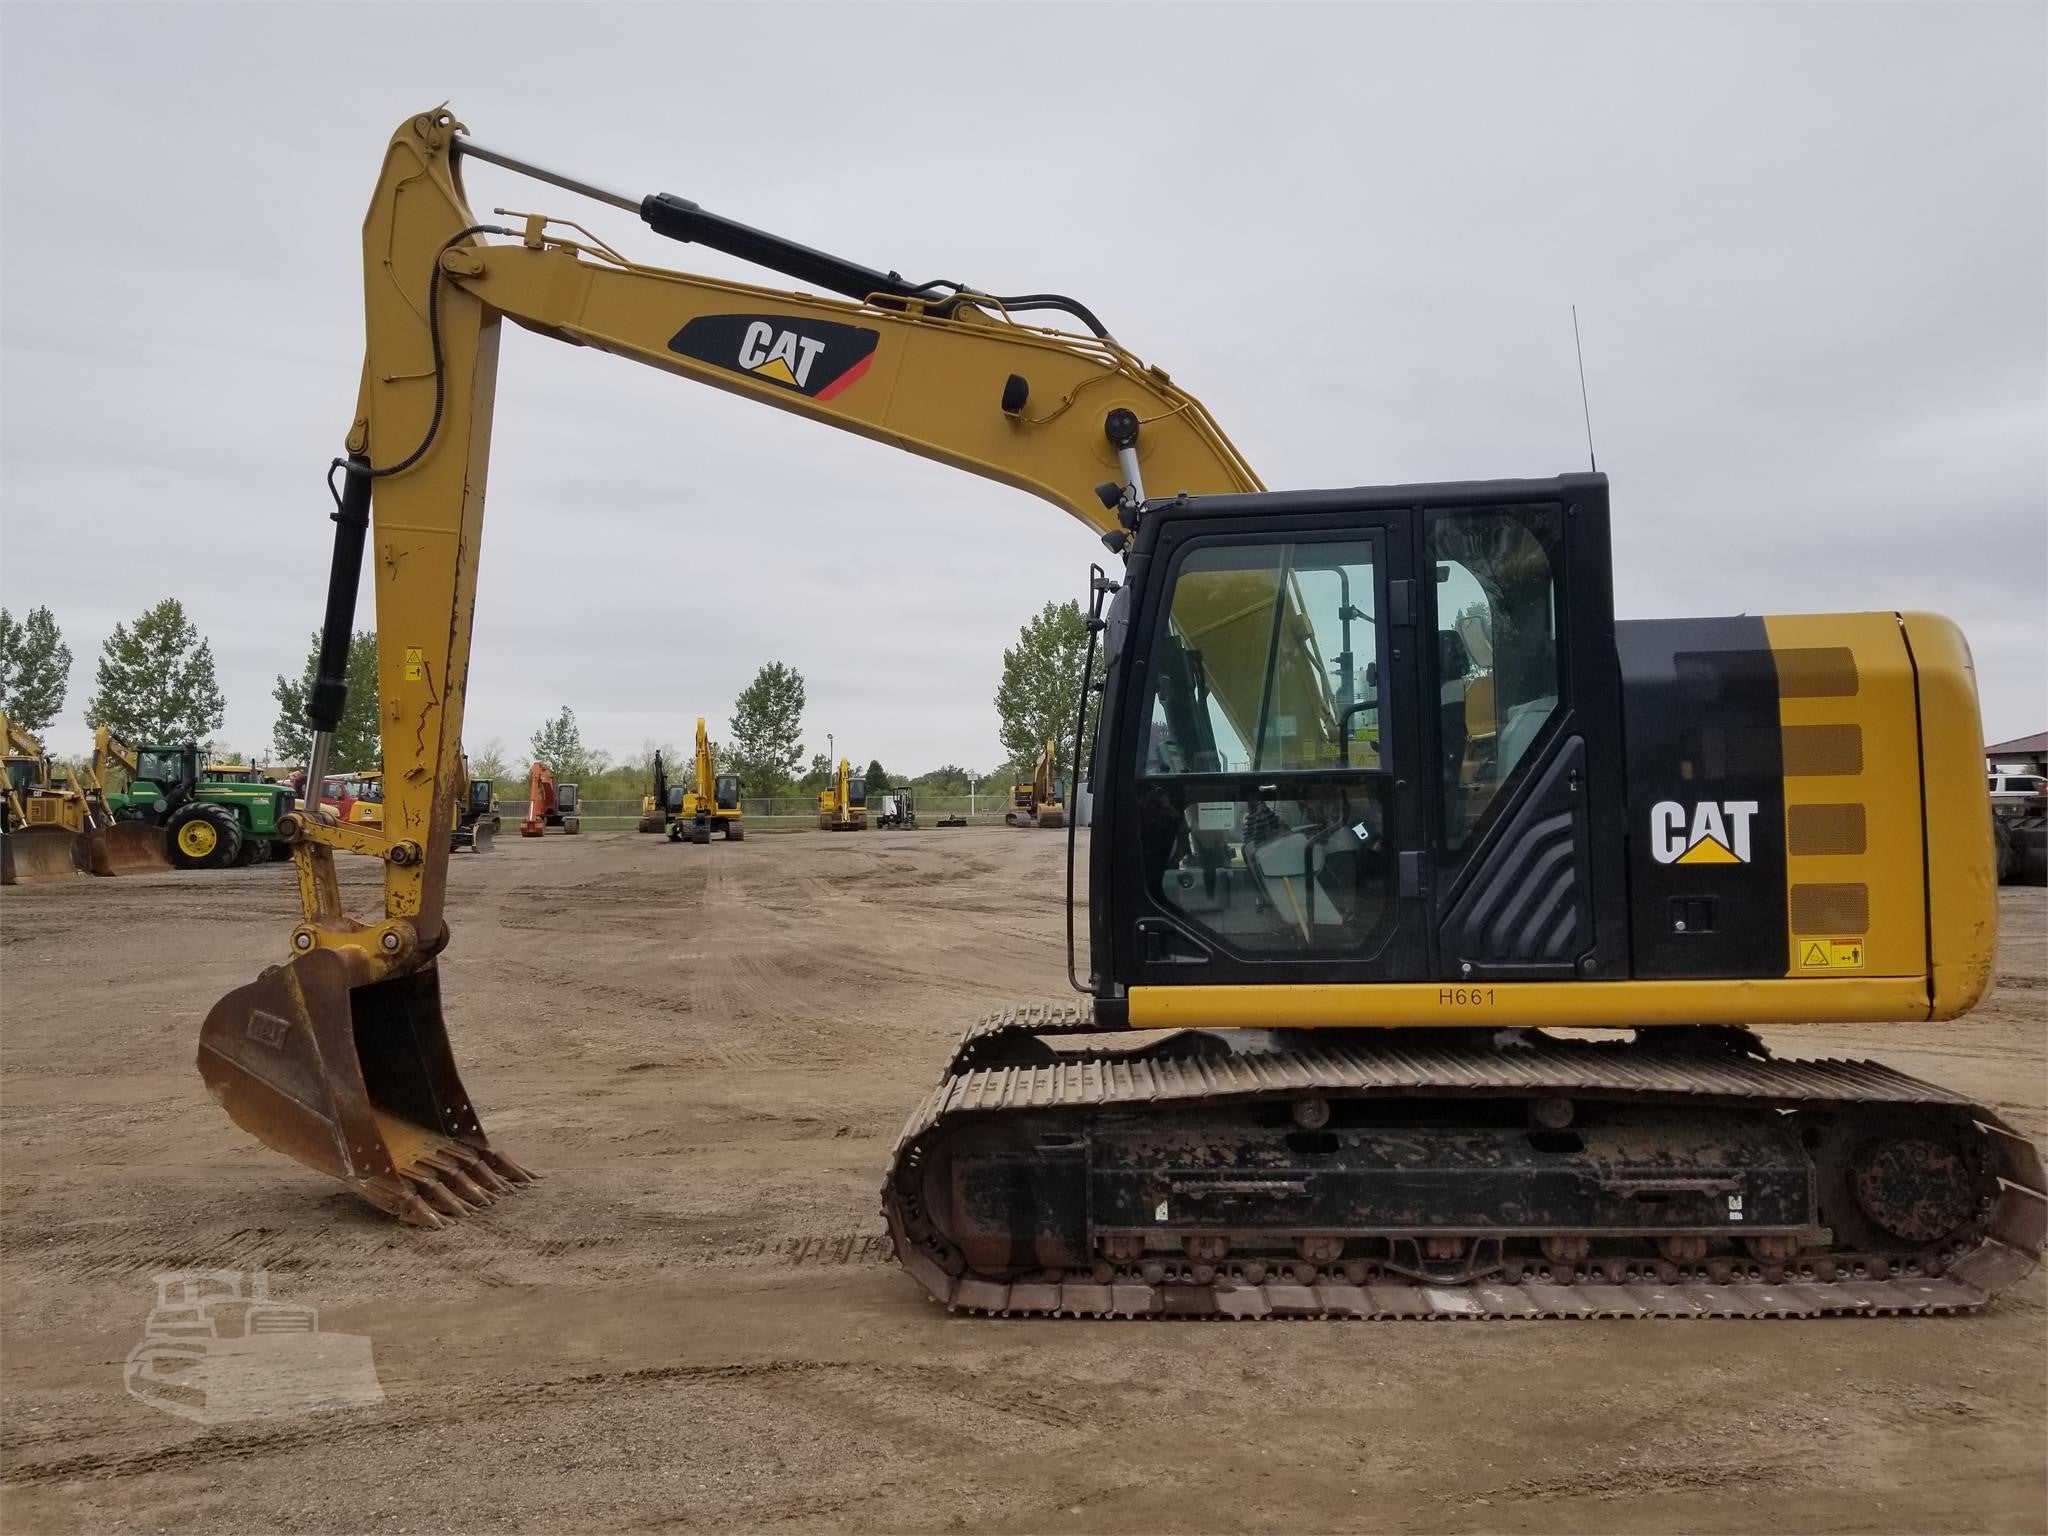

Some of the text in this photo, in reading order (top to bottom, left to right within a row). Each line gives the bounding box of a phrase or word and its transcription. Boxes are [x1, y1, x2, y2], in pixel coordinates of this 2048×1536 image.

[738, 321, 825, 388] CAT
[1651, 801, 1758, 864] CAT
[1439, 988, 1494, 1006] H661
